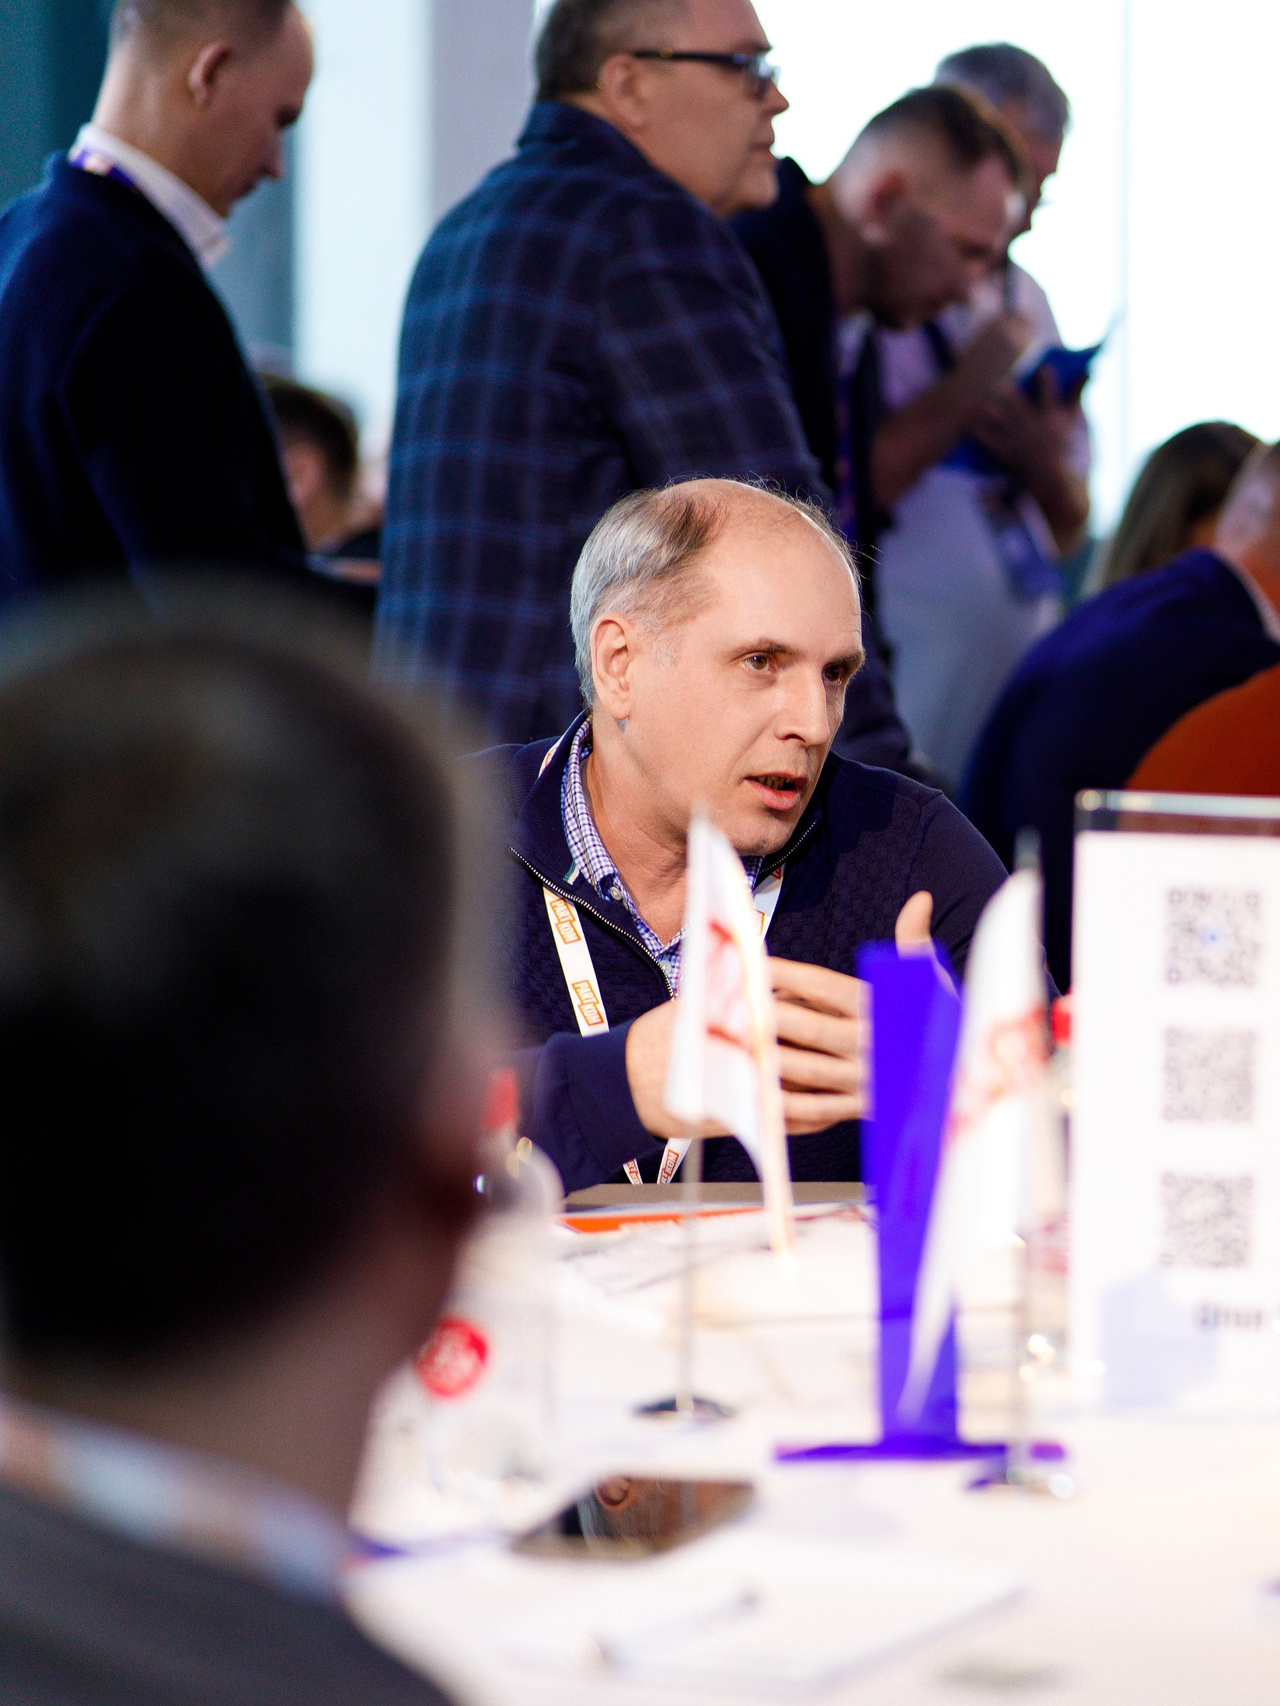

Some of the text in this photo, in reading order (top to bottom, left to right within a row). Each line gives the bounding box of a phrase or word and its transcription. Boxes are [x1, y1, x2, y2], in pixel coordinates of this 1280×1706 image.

[552, 899, 579, 943] PART KOM
[574, 982, 602, 1024] PART KOM
[665, 1150, 678, 1175] KOM
